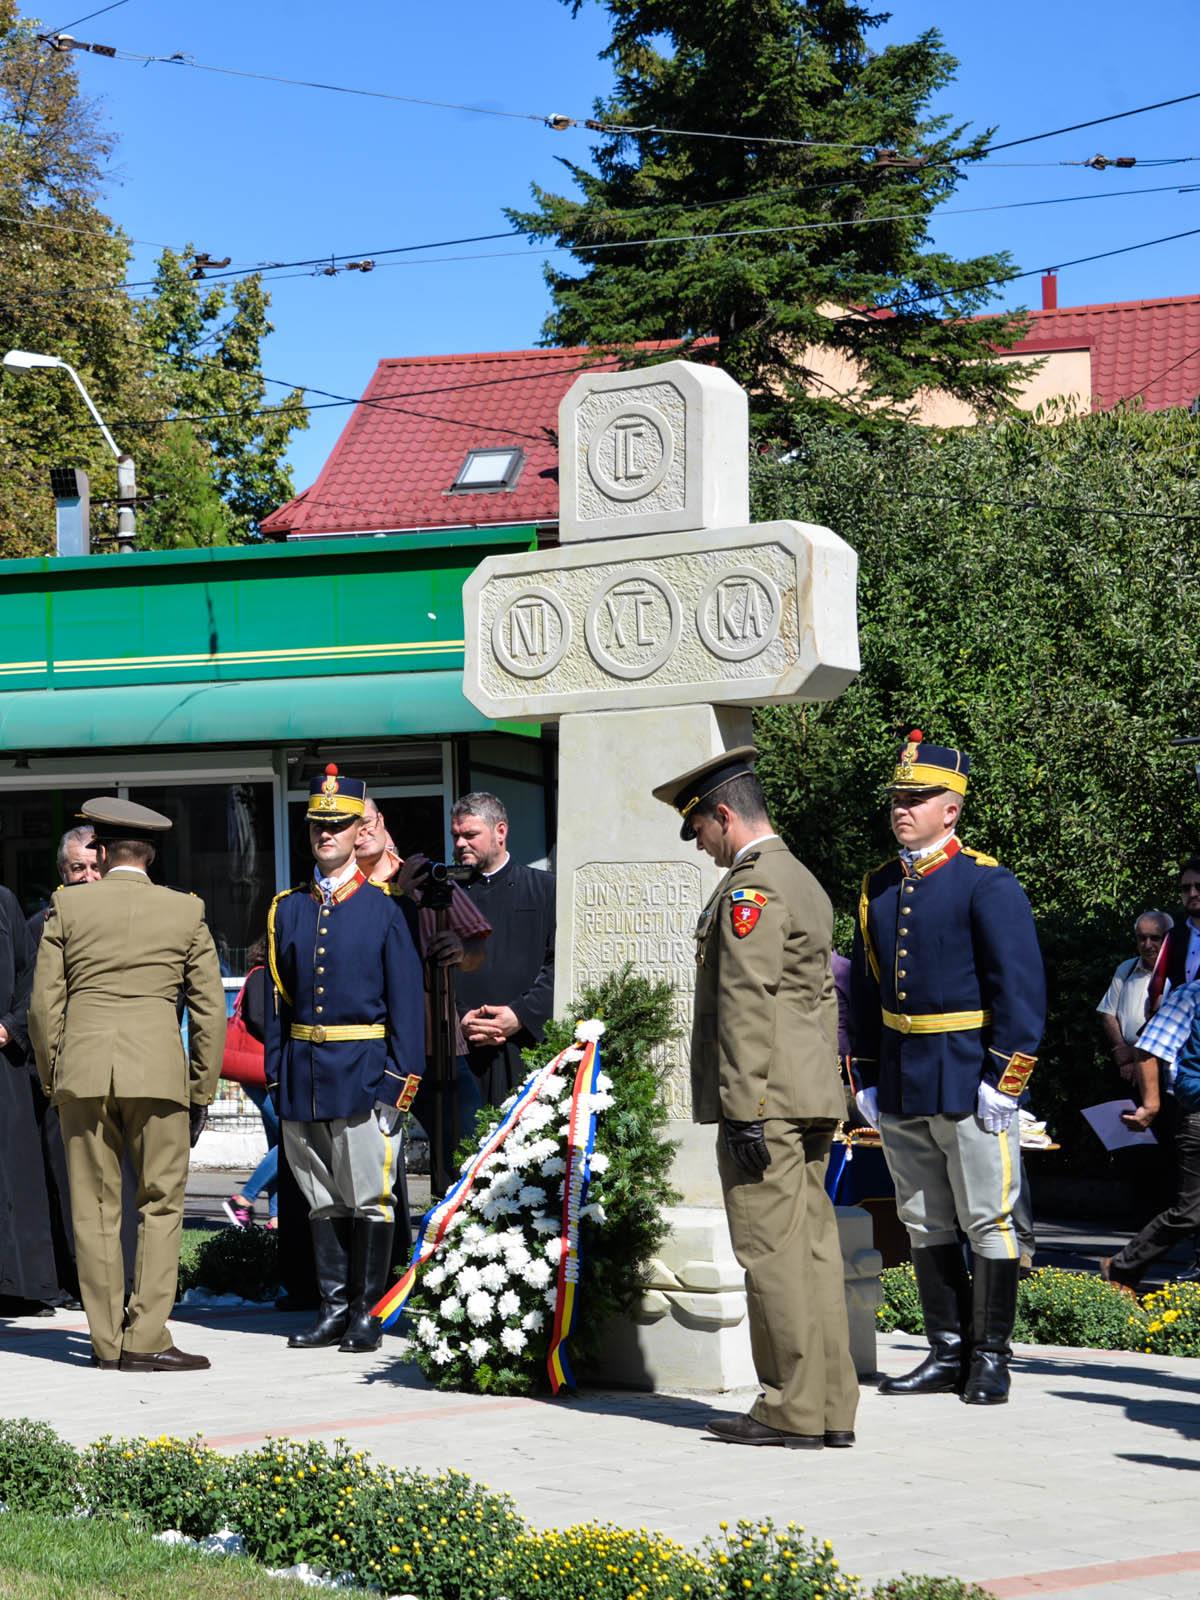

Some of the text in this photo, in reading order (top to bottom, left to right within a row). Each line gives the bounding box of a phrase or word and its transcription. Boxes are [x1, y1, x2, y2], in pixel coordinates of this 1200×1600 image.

[584, 882, 691, 906] UN VEAC DE
[600, 939, 685, 963] EROILOR
